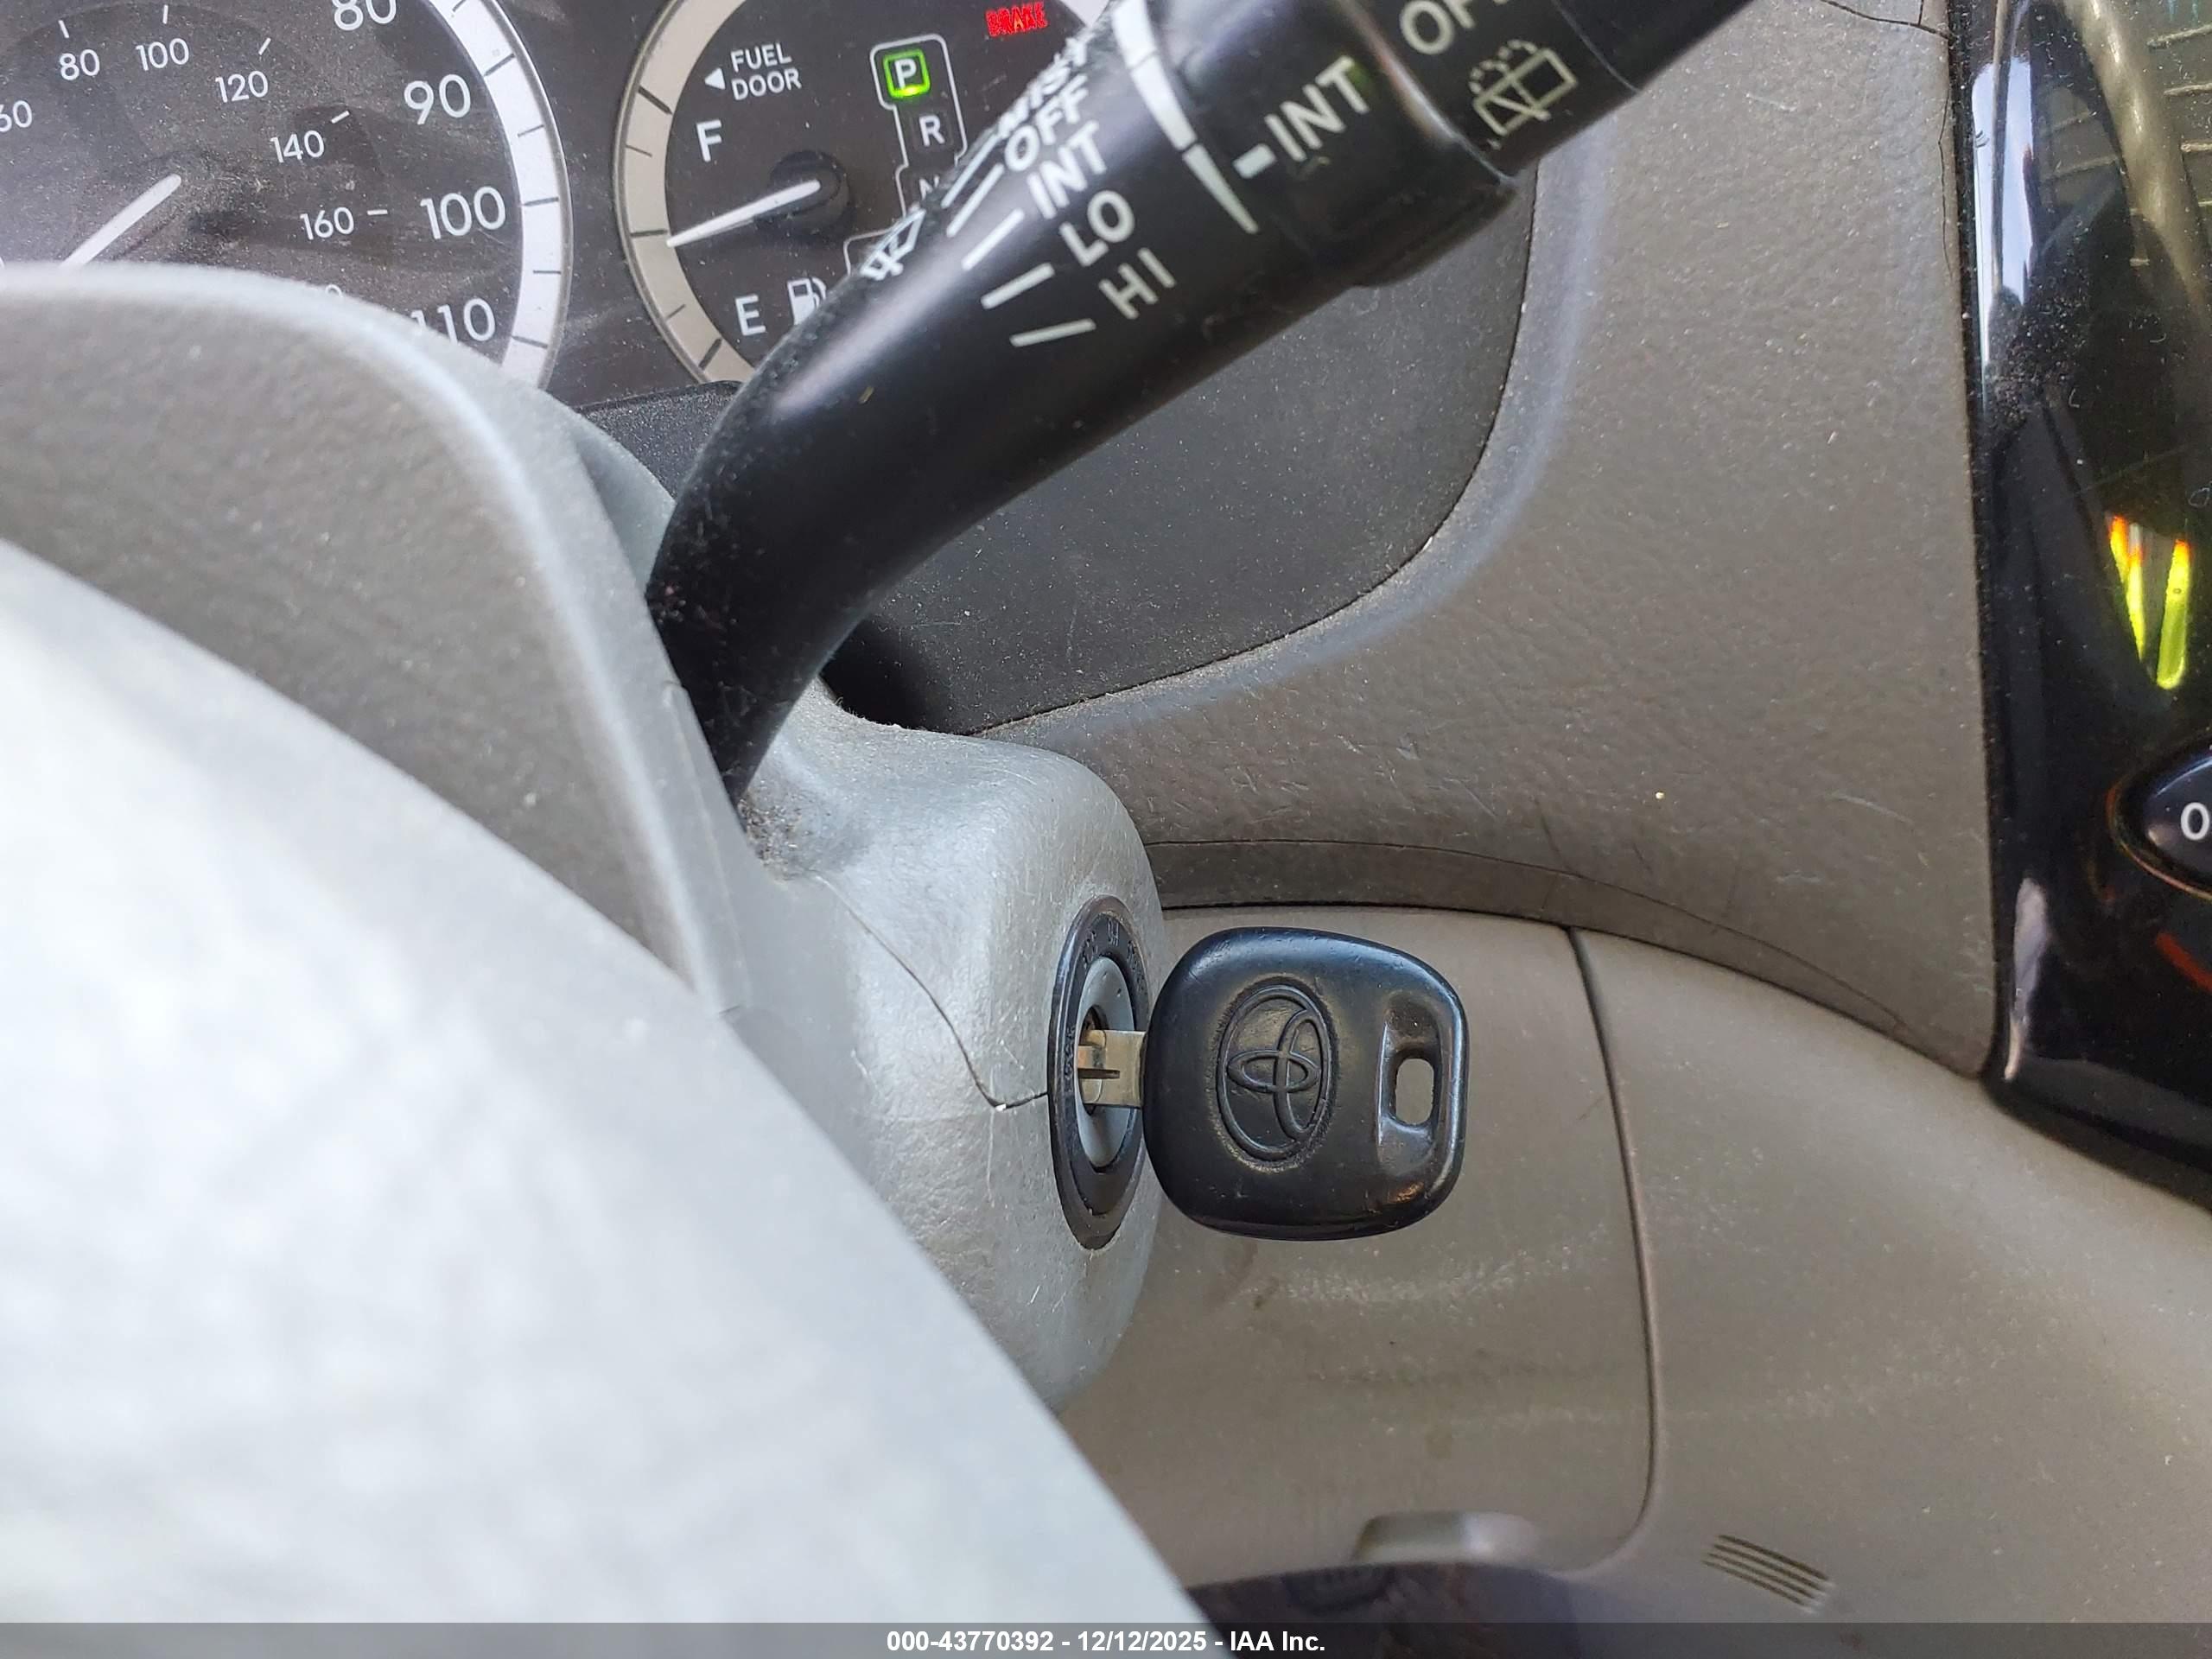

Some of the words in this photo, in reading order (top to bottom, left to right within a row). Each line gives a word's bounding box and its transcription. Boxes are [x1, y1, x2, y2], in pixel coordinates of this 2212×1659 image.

[332, 0, 397, 31] 80
[985, 2, 1048, 37] BRAKE
[60, 49, 99, 80] 80
[136, 38, 189, 71] 100
[731, 43, 791, 73] FUEL
[215, 71, 268, 103] 120
[731, 67, 801, 100] DOOR
[894, 58, 916, 87] P
[404, 73, 471, 124] 90
[1265, 56, 1369, 162] INT
[918, 114, 945, 146] R
[1005, 73, 1088, 172] OFF
[270, 130, 324, 163] 140
[696, 119, 722, 162] F
[1027, 120, 1108, 219] INT
[300, 207, 353, 240] 160
[420, 187, 506, 240] 100
[1059, 189, 1135, 266] LO
[1099, 248, 1176, 320] HI
[734, 295, 766, 335] E
